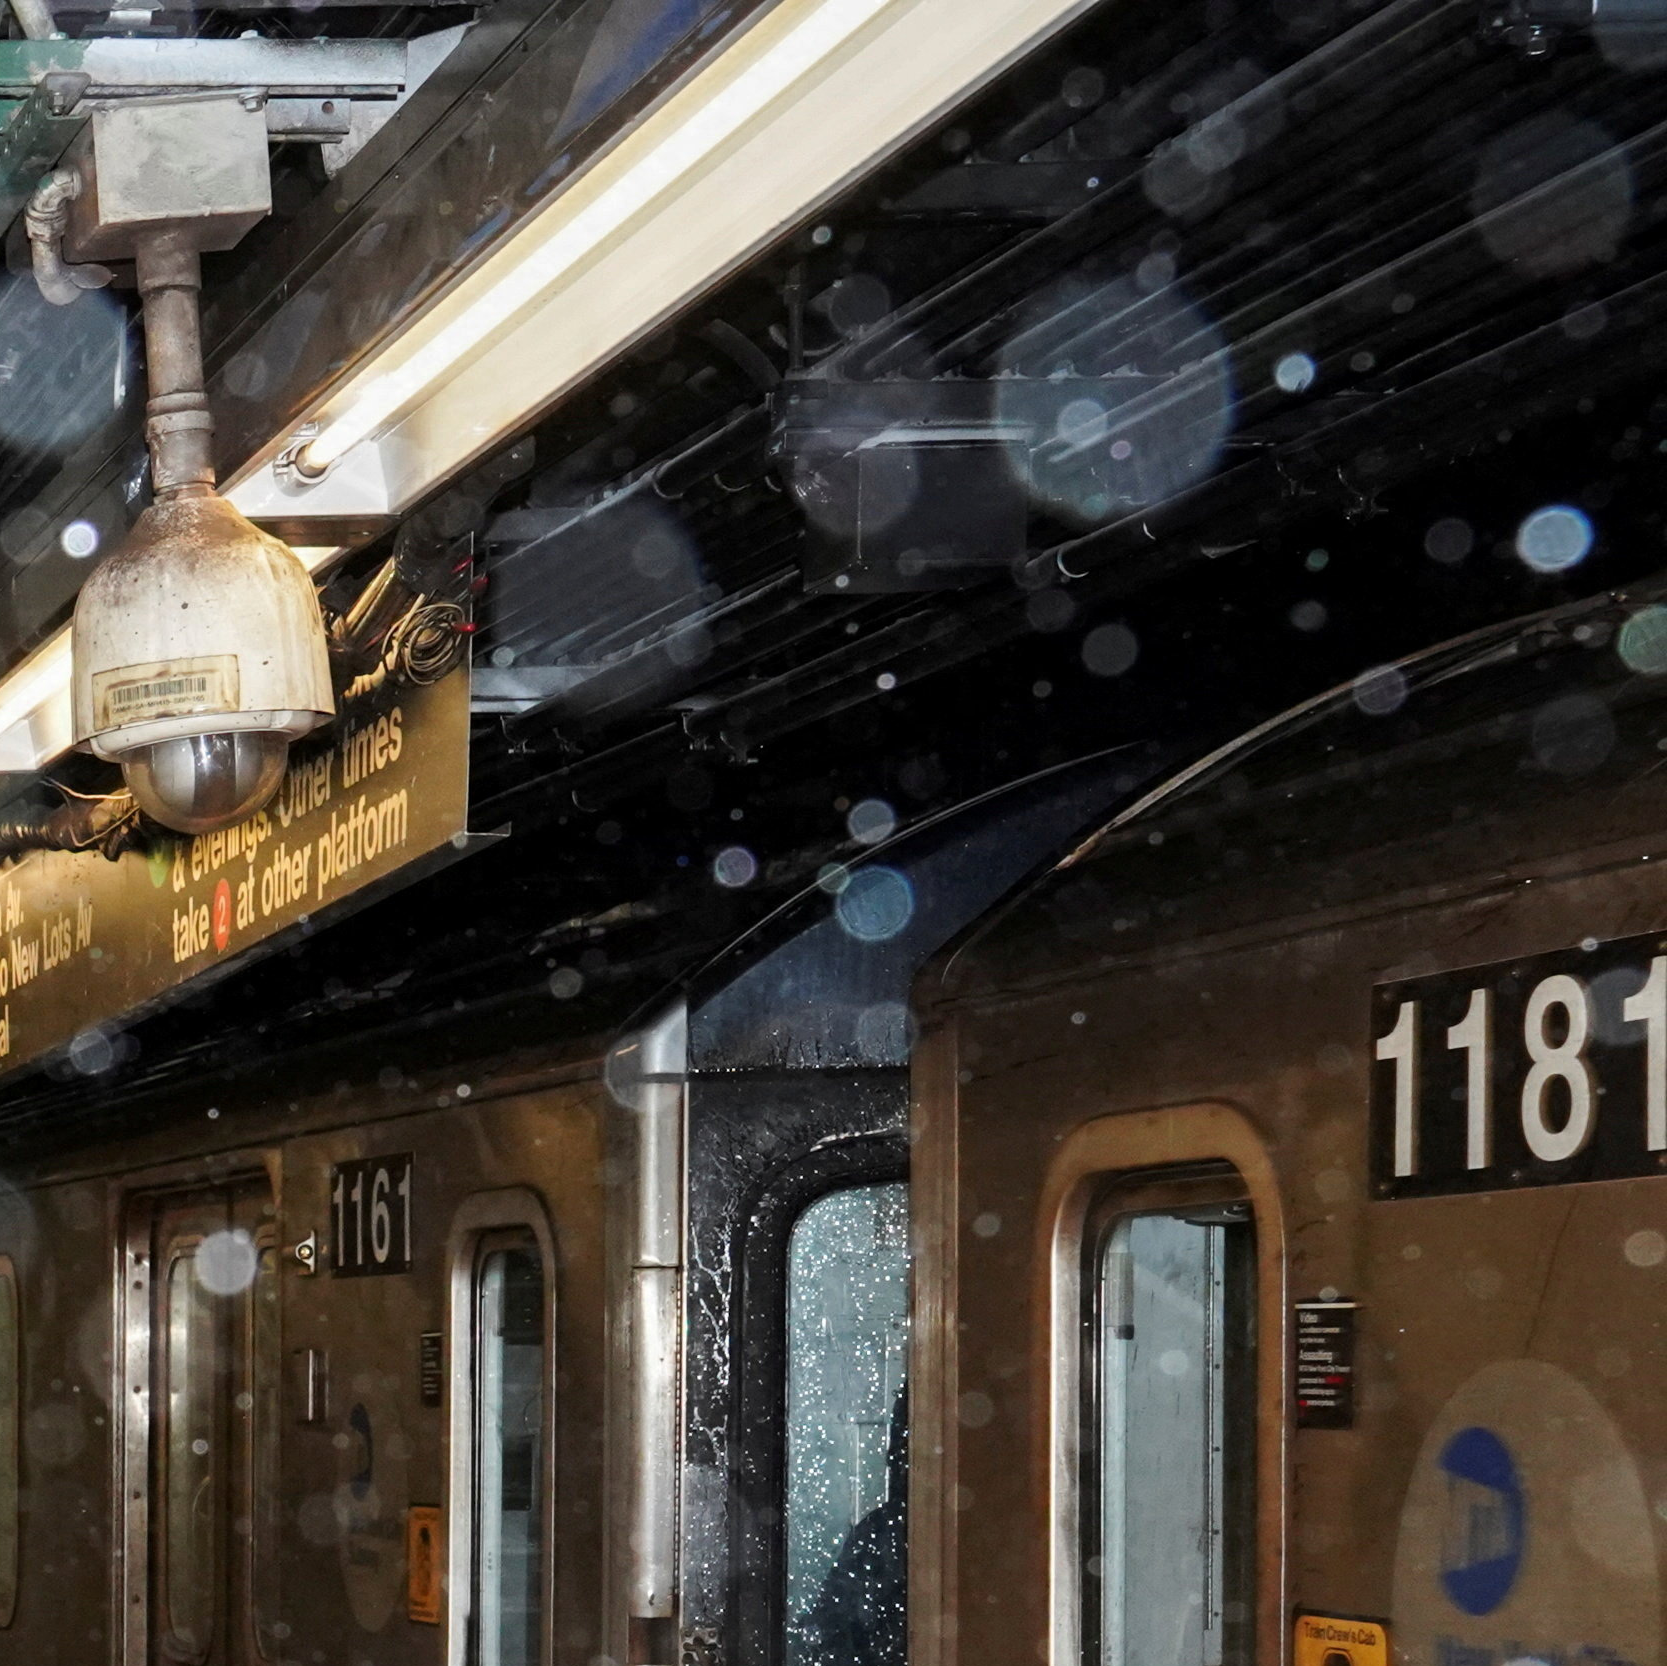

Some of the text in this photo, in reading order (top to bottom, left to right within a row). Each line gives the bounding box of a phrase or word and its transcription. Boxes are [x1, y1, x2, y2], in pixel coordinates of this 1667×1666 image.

[173, 841, 186, 893] &
[343, 706, 403, 789] times
[6, 880, 24, 932] Av.
[12, 936, 39, 990] New
[43, 912, 71, 971] Lots
[76, 896, 93, 952] Av
[173, 788, 408, 963] take 2 at other platform
[1375, 955, 1667, 1178] 1181
[333, 1164, 411, 1267] 1161
